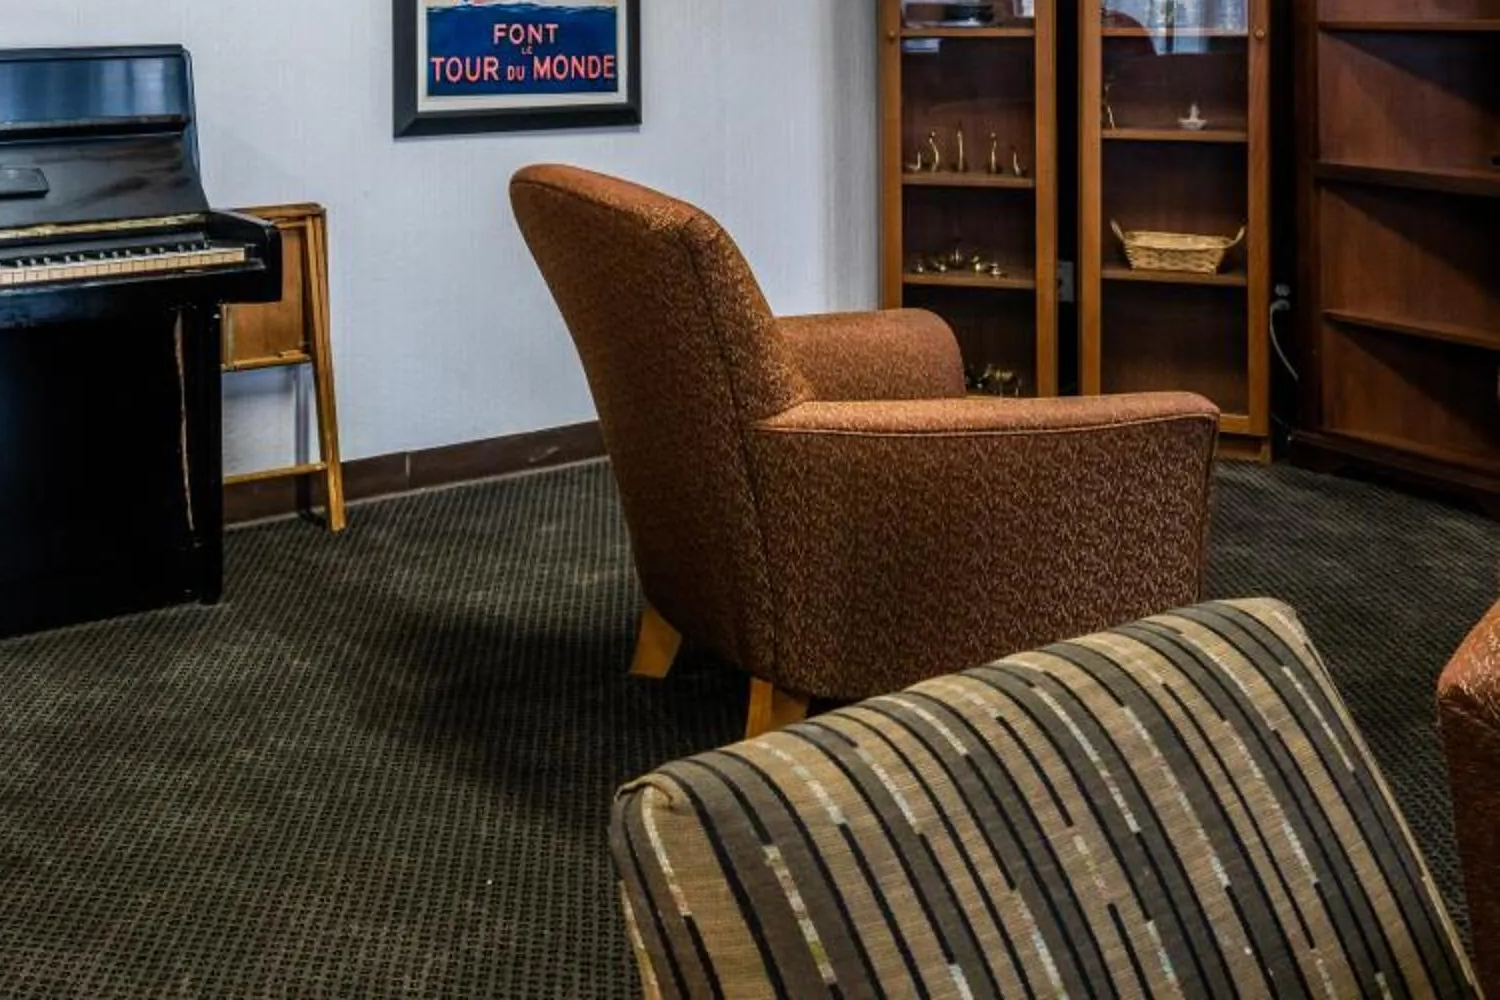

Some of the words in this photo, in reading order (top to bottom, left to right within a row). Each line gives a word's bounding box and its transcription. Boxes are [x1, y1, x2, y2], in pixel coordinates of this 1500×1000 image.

[492, 23, 559, 45] FONT
[521, 46, 533, 55] LE
[430, 56, 499, 82] TOUR
[506, 65, 525, 81] DU
[533, 55, 615, 80] MONDE
